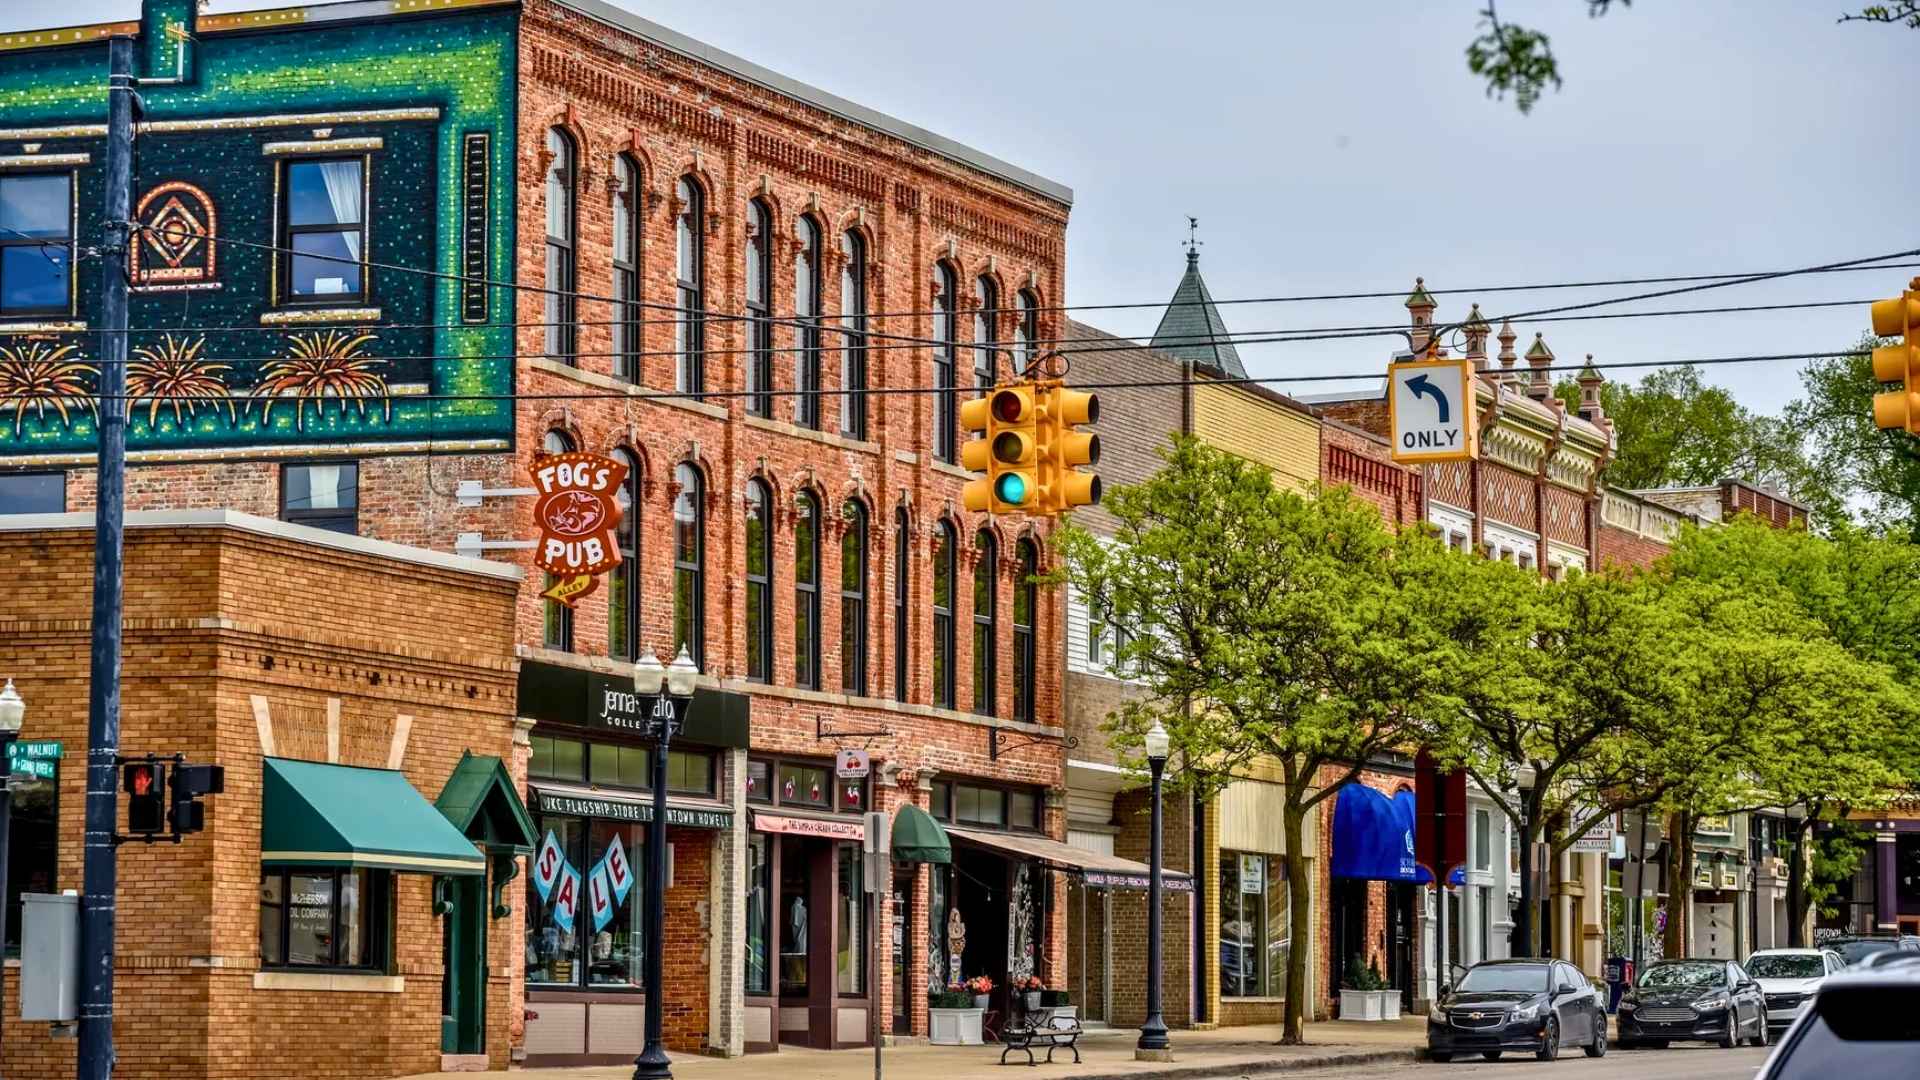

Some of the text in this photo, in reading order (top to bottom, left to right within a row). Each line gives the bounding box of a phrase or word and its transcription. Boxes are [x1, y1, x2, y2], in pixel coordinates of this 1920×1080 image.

[1403, 429, 1458, 449] ONLY
[537, 462, 610, 493] FOG'S
[544, 537, 604, 568] PUB
[557, 582, 584, 597] ALLEY
[27, 743, 58, 756] WALNUT
[566, 800, 609, 815] FLAGSHIP
[613, 803, 638, 818] STORE
[699, 811, 730, 827] HOWELL
[540, 846, 626, 915] SALE
[301, 907, 329, 919] COMPANY
